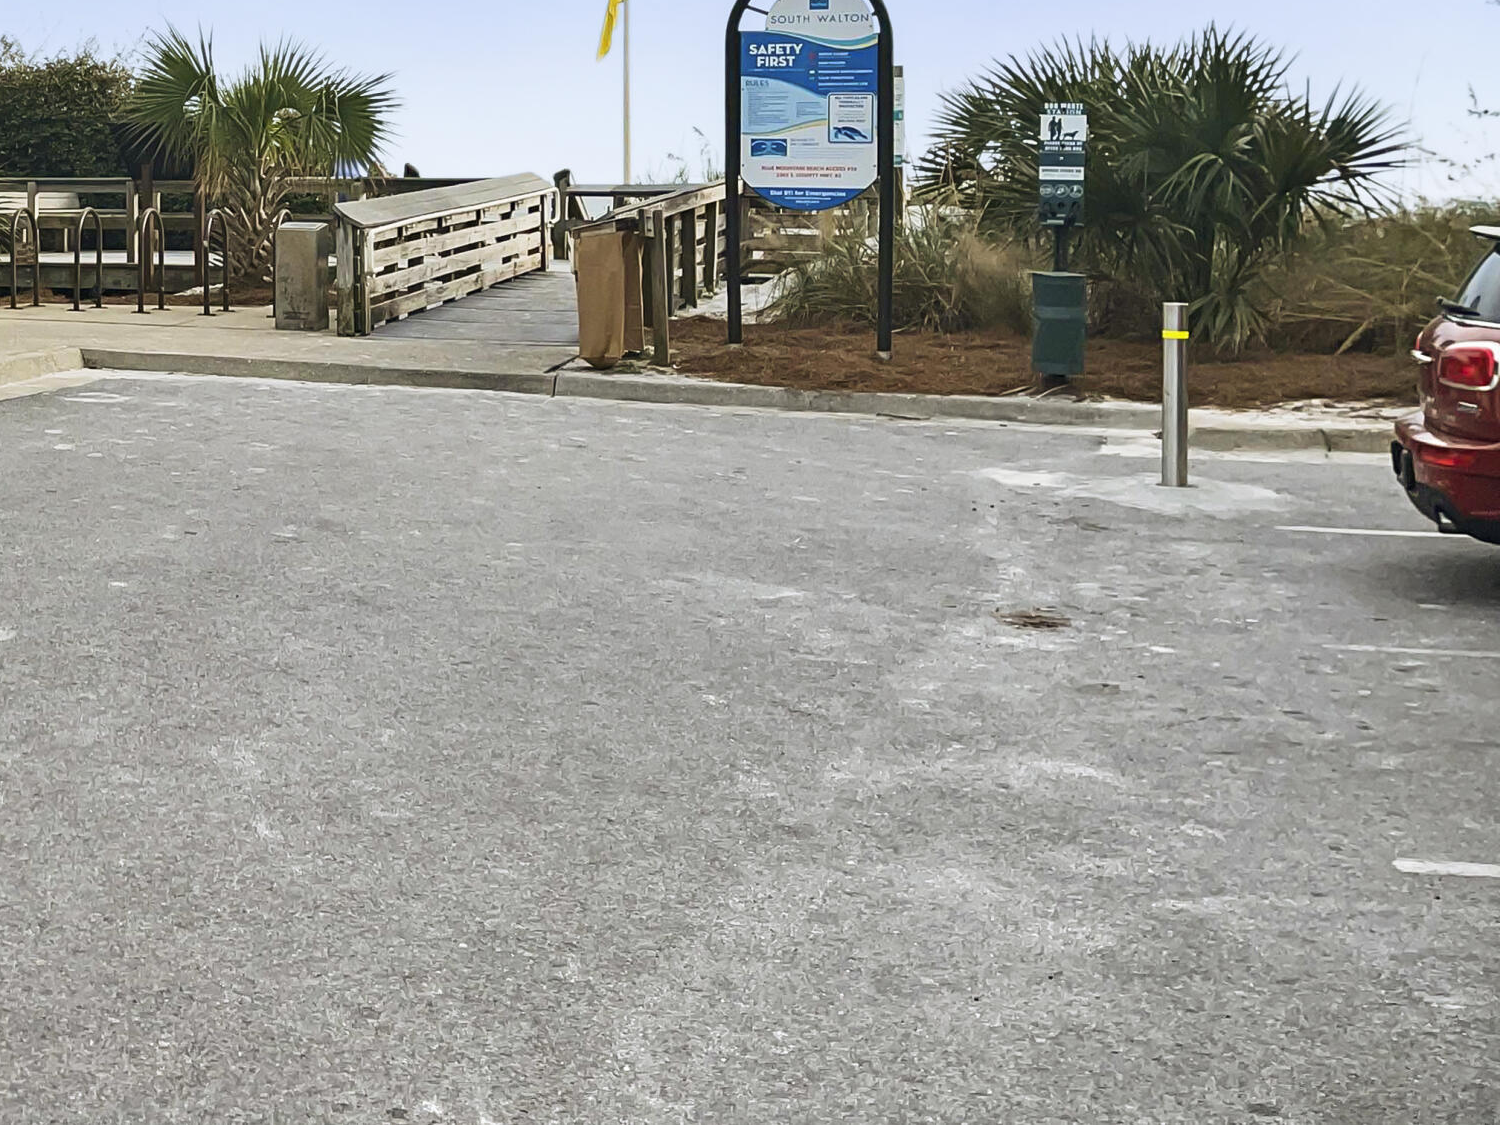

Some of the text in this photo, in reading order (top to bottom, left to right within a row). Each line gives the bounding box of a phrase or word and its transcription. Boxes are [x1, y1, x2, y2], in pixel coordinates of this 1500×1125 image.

[770, 13, 869, 24] SOUTH WALTON
[748, 43, 803, 55] SAFETY
[756, 56, 795, 67] FIRST
[745, 79, 770, 87] RULES
